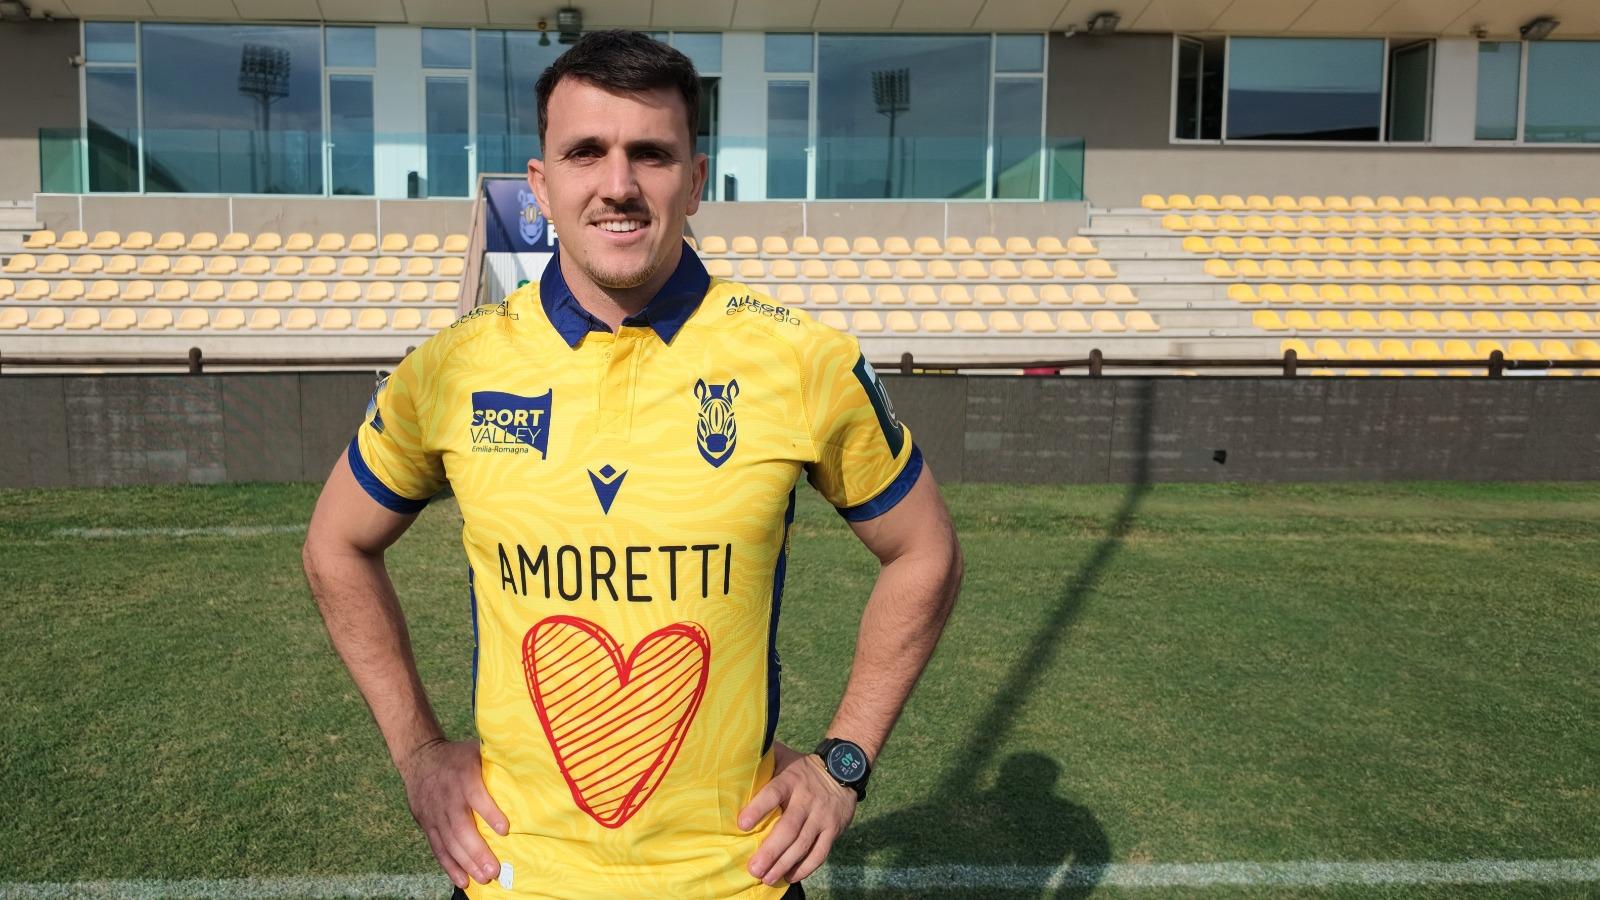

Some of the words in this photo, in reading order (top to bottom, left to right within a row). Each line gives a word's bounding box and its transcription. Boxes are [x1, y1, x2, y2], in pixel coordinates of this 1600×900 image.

[726, 294, 790, 317] ALLEGRI
[726, 304, 801, 326] ecologia
[471, 408, 545, 427] SPORT
[470, 427, 542, 445] VALLEY
[471, 445, 529, 455] Emilia-Romagna
[498, 542, 732, 603] AMORETTI
